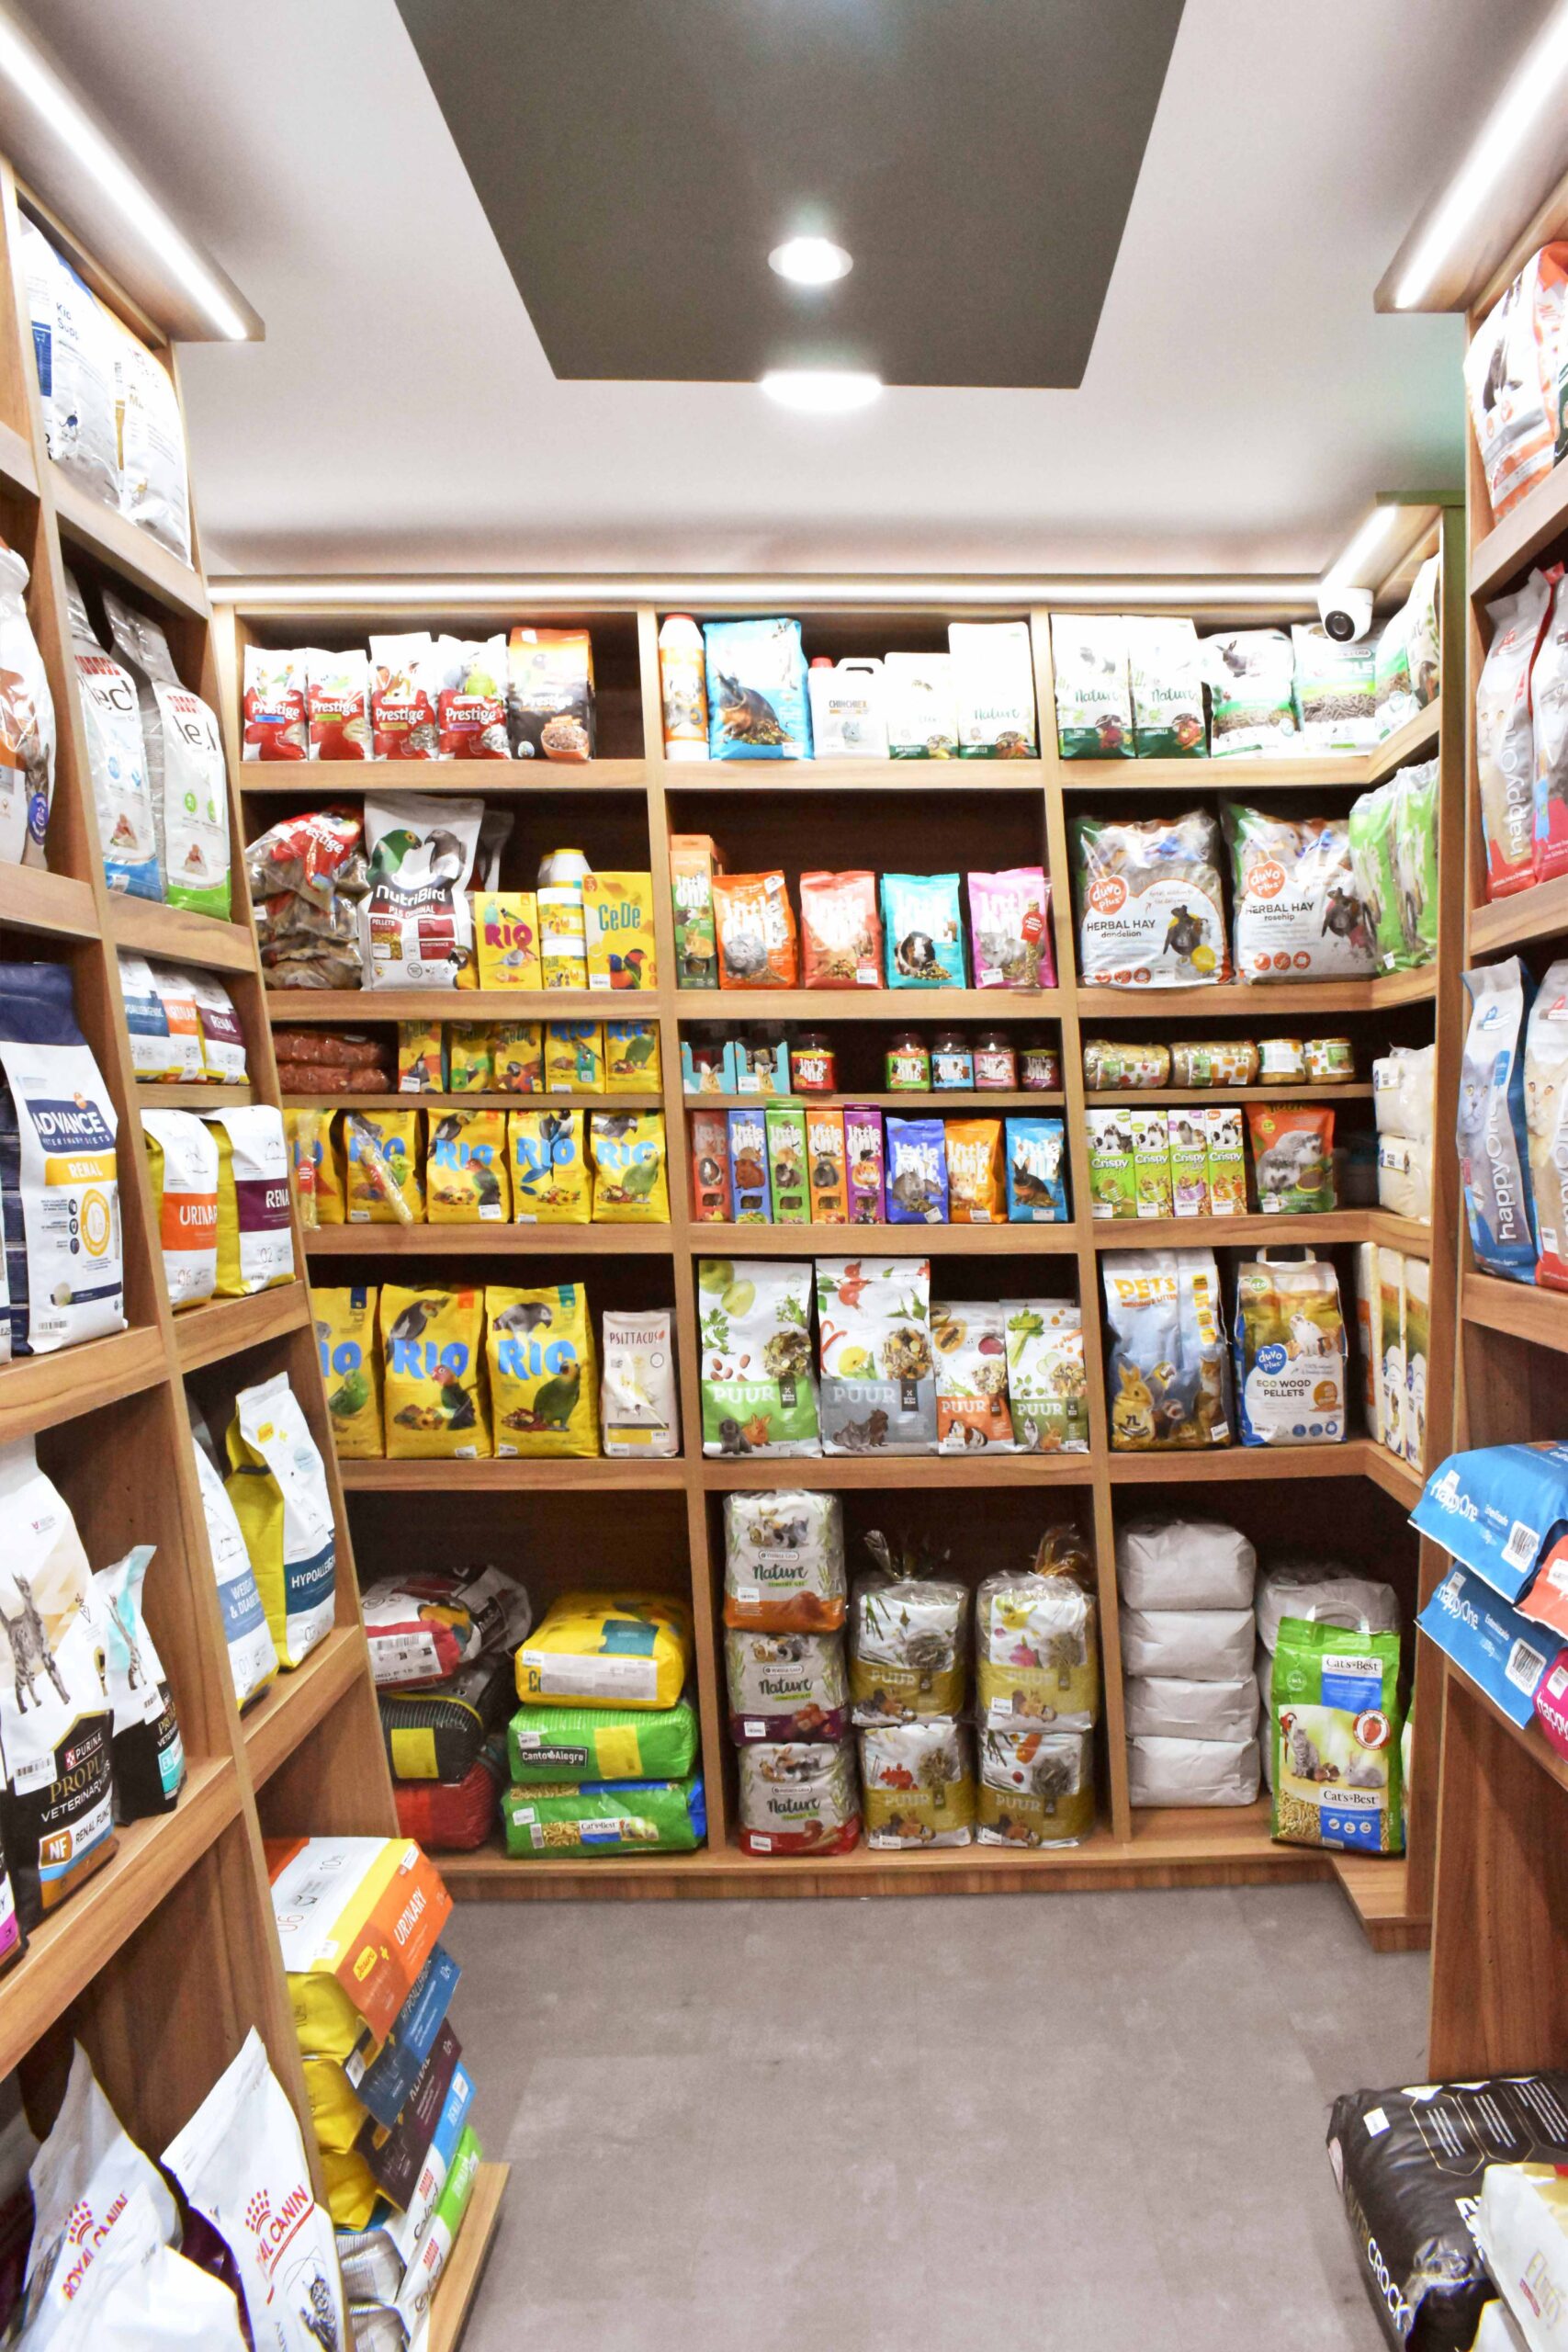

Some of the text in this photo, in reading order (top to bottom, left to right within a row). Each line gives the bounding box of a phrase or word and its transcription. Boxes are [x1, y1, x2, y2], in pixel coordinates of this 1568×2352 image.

[310, 698, 359, 716] Prestige
[375, 707, 424, 724] Prestige
[446, 707, 497, 725] Prestige
[1250, 867, 1280, 886] duvo
[376, 885, 446, 906] NutriBird
[1092, 884, 1122, 901] duvo
[1257, 882, 1280, 895] plus
[1099, 897, 1122, 911] plus
[1246, 902, 1314, 914] HERBAL HAY
[1087, 919, 1156, 932] HERBAL HAY
[1264, 913, 1295, 922] rosehip
[484, 922, 533, 949] RIO
[209, 1014, 237, 1033] RENAL
[31, 1112, 105, 1136] ADVANCE
[435, 1138, 494, 1171] RIO
[516, 1137, 575, 1170] RIO
[1134, 1153, 1168, 1164] Crispy
[1172, 1153, 1205, 1164] Crispy
[1209, 1152, 1242, 1163] Crispy
[68, 1162, 103, 1179] RENAL
[1091, 1158, 1129, 1170] Crispy
[266, 1189, 290, 1209] RENA
[610, 1331, 660, 1345] PSITTACUS
[392, 1339, 469, 1380] RIO
[1258, 1351, 1282, 1363] duvo
[1264, 1362, 1280, 1371] plus
[1256, 1379, 1312, 1388] ECO WOOD
[713, 1385, 775, 1404] PUUR
[833, 1385, 896, 1404] PUUR
[1263, 1388, 1305, 1397] PELLETS
[942, 1400, 987, 1413] PUUR
[1017, 1403, 1063, 1416] PUUR
[752, 1564, 808, 1580] Nature
[231, 1605, 238, 1619] &
[1326, 1659, 1378, 1671] Cat's Best
[870, 1669, 916, 1686] PUUR
[759, 1678, 814, 1695] Nature
[75, 1732, 104, 1758] PURINA
[522, 1751, 584, 1764] Canto Alegre
[886, 1793, 931, 1806] PUUR
[996, 1794, 1041, 1811] PUUR
[1324, 1790, 1376, 1804] Cat's Best
[767, 1798, 820, 1814] Nature
[75, 1820, 96, 1845] RENAL
[50, 1838, 67, 1860] NF
[393, 1886, 427, 1946] URINARY
[267, 2184, 310, 2245] CANIN
[62, 2189, 129, 2301] ROYAL CANIN
